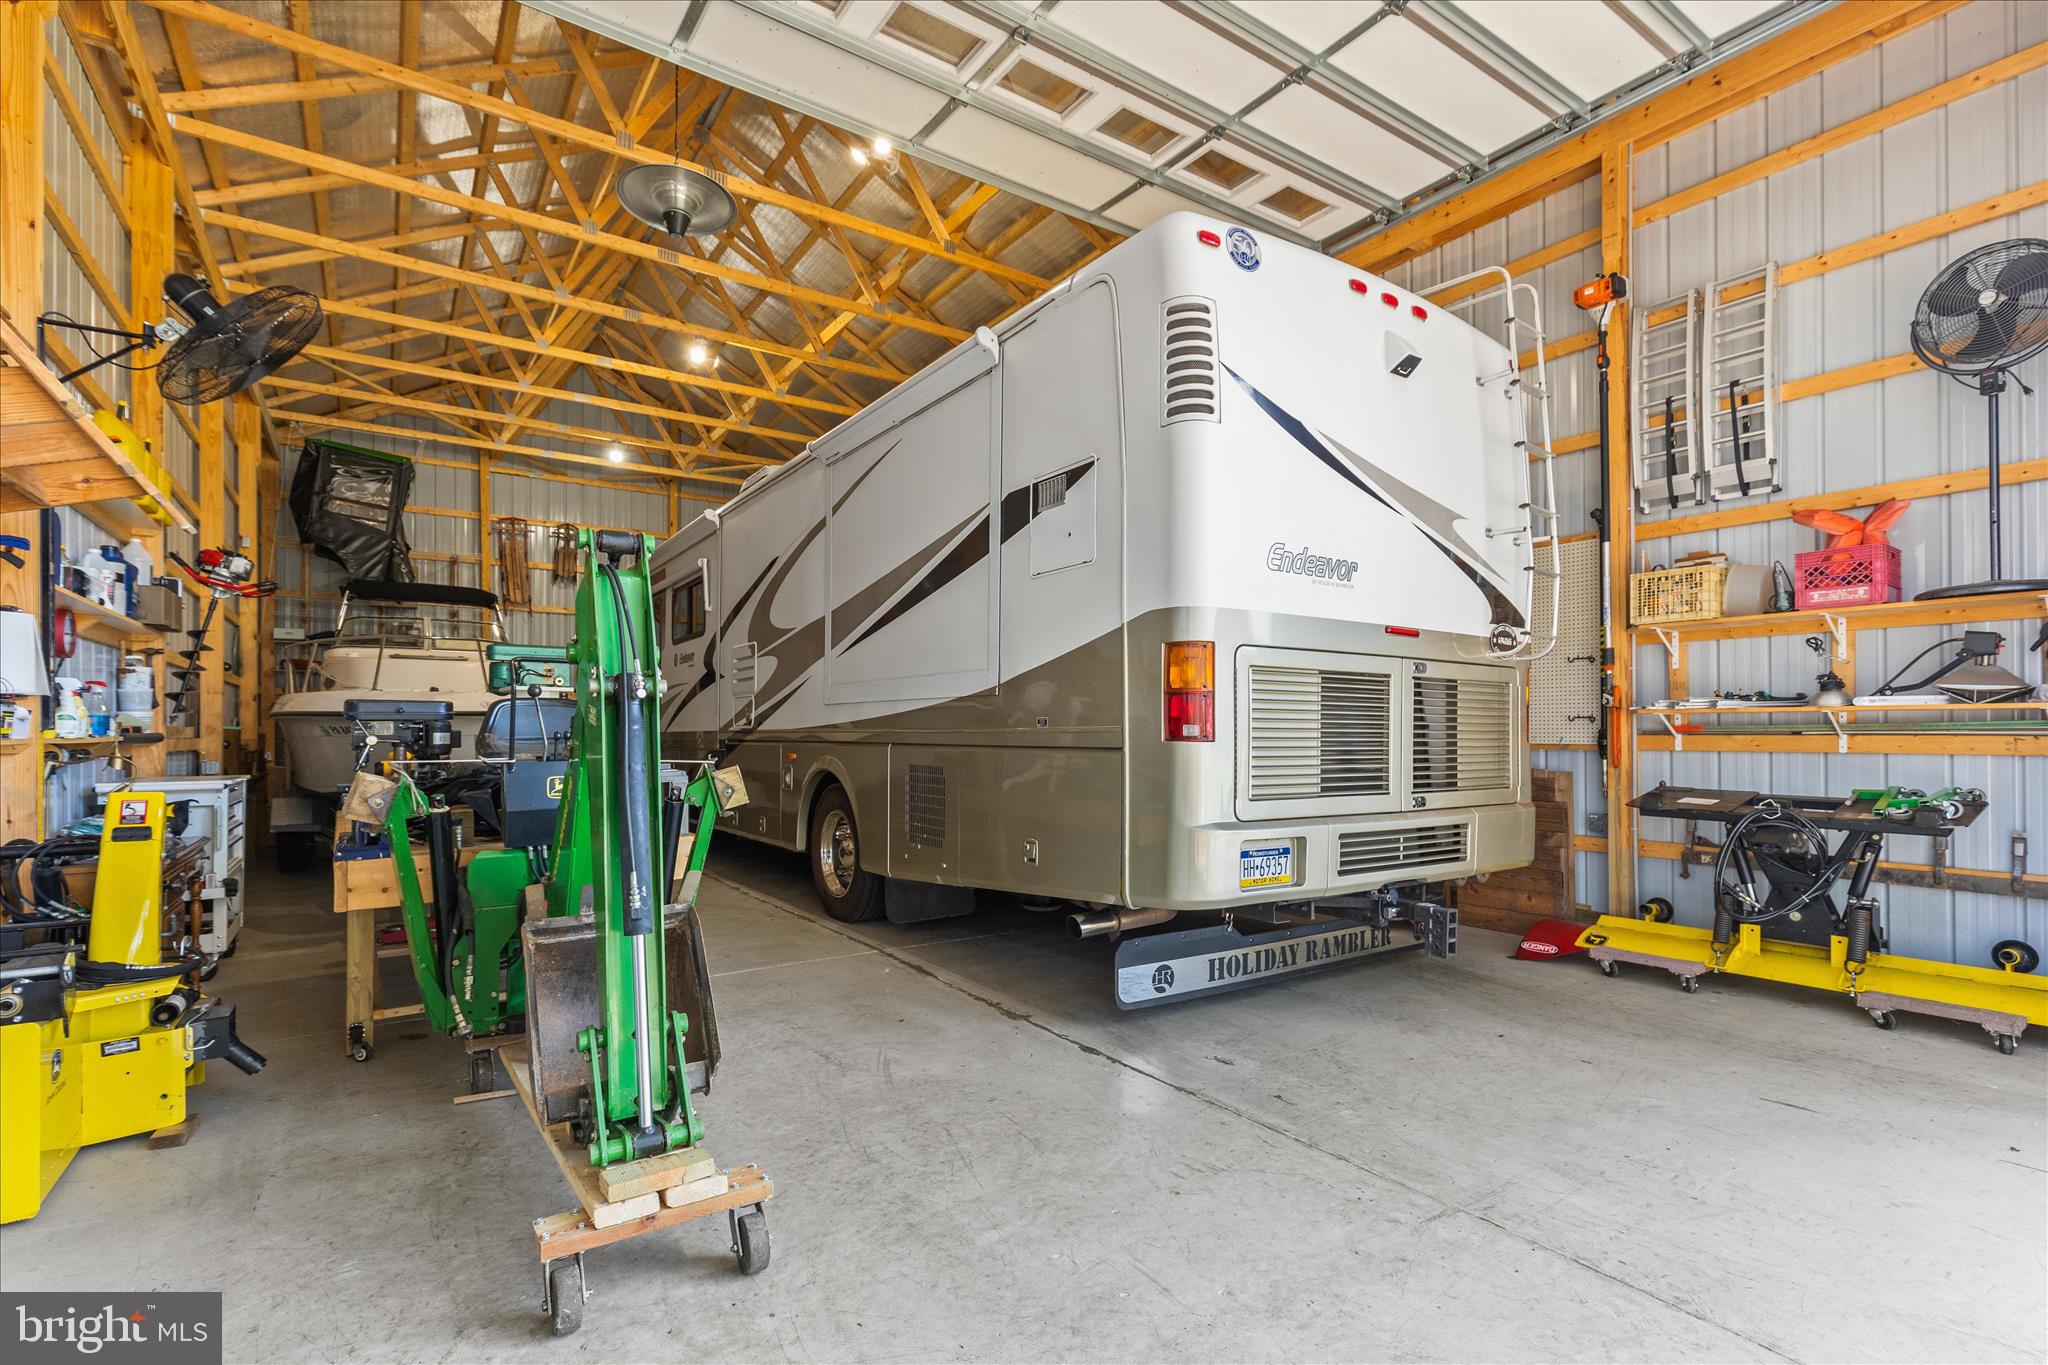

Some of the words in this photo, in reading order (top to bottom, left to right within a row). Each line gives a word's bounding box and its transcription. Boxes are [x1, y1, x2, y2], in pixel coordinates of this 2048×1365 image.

[1267, 542, 1358, 582] Endeavor
[1207, 943, 1300, 983] HOLIDAY
[1305, 926, 1392, 963] RAMBLER
[1524, 942, 1556, 953] DANGER
